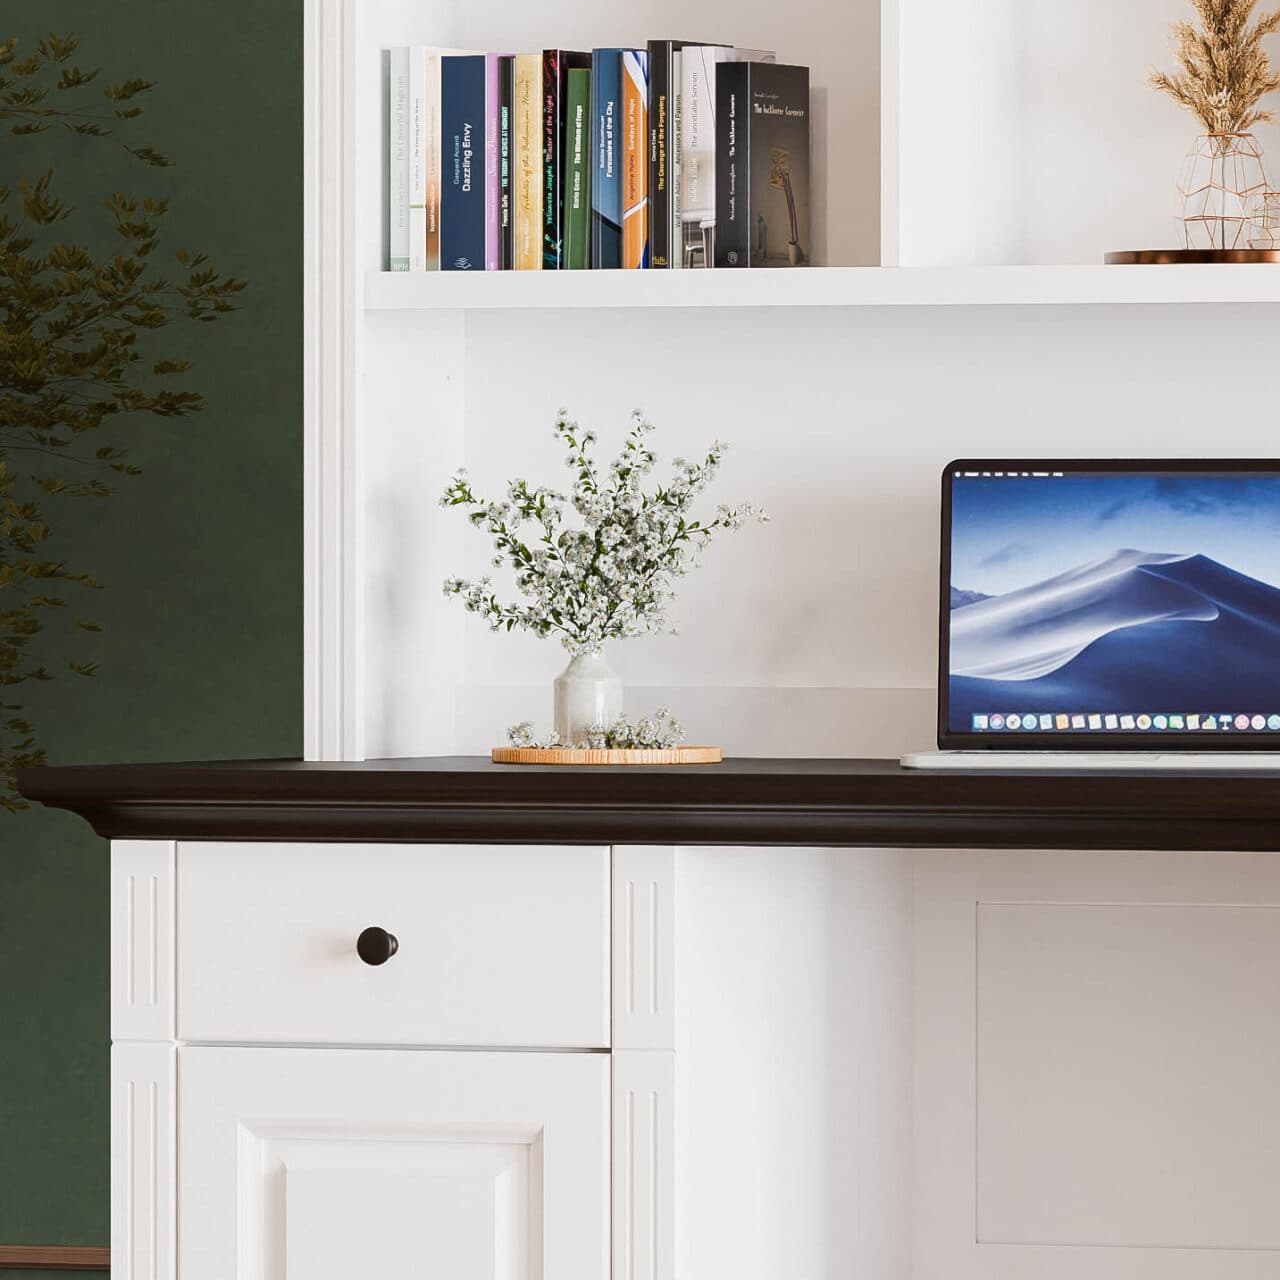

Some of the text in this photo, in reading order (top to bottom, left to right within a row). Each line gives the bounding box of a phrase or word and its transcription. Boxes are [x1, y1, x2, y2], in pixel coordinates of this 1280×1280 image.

[606, 101, 614, 116] City
[674, 120, 682, 132] and
[606, 130, 612, 139] of
[690, 134, 698, 148] The
[658, 140, 665, 148] of
[462, 122, 472, 192] Dazzling Envy
